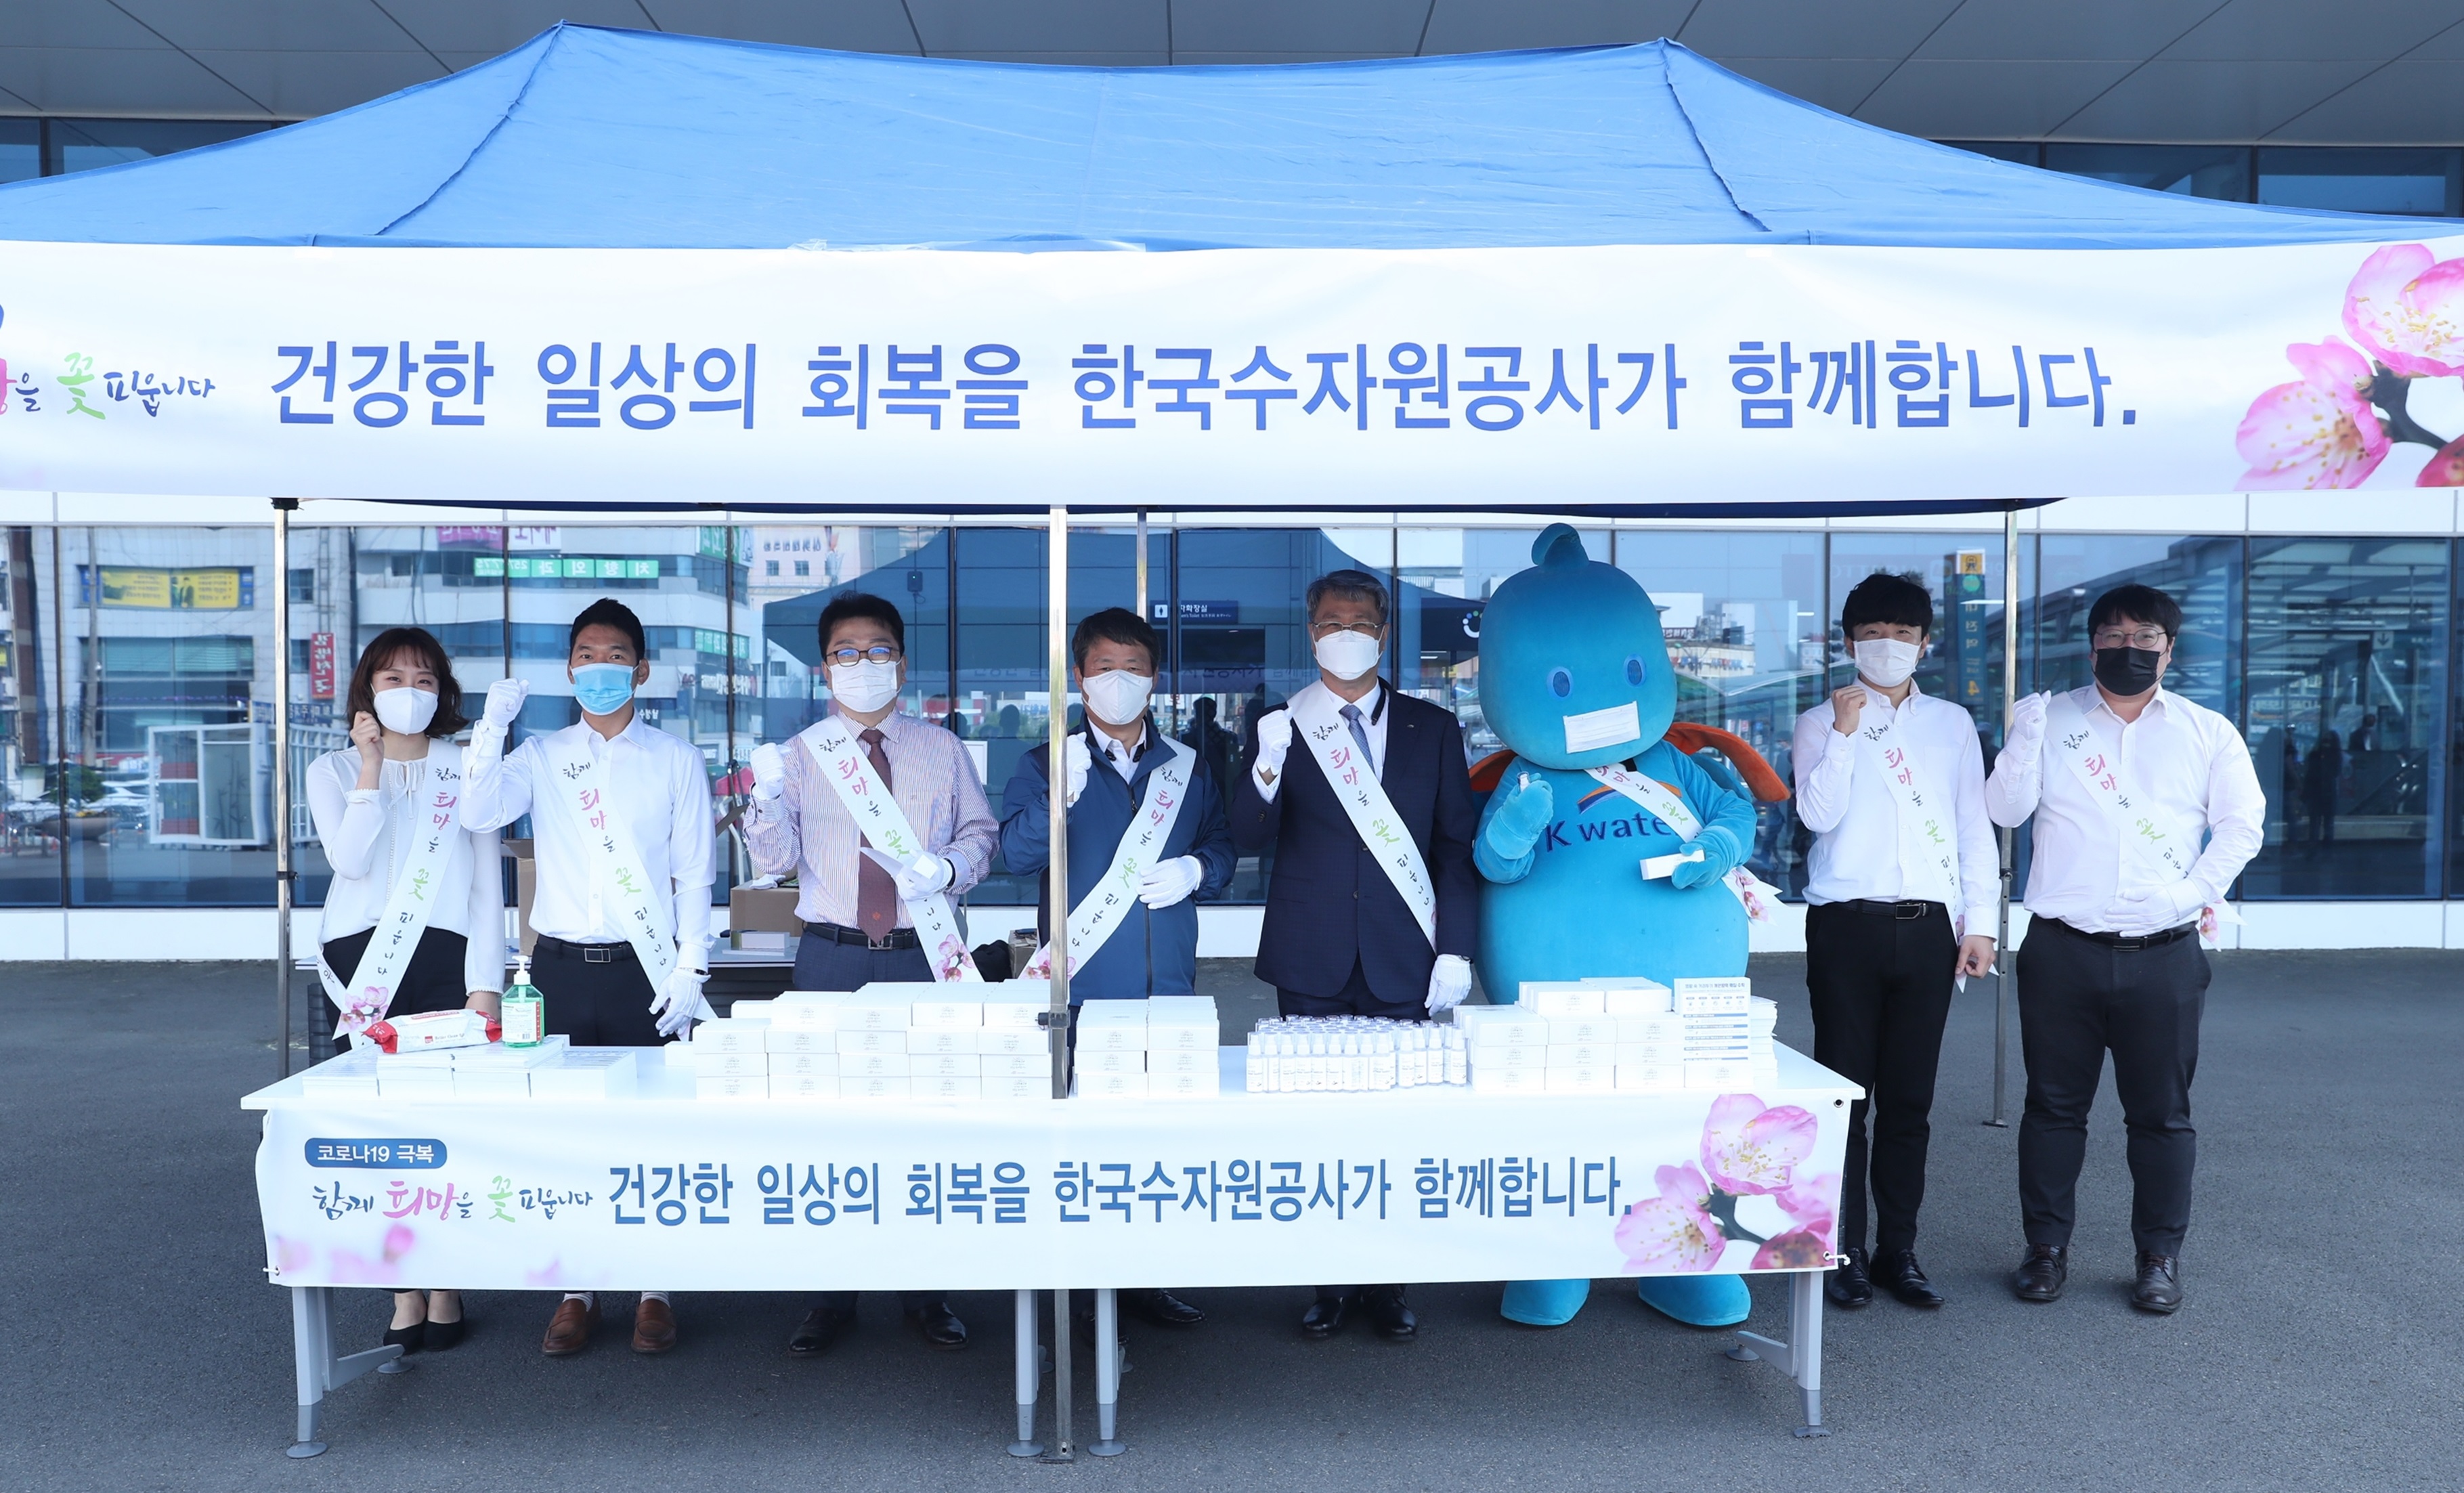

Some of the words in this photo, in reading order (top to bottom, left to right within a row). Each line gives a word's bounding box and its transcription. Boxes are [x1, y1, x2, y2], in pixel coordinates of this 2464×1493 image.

[271, 341, 494, 429] 건강한
[537, 342, 756, 431] 일상의
[802, 343, 1029, 431] 회복을
[1072, 342, 1687, 432] 한국수자원공사가
[1729, 340, 2136, 429] 함께합니다.
[1312, 722, 1339, 741] 함께
[1863, 724, 1890, 741] 함께
[2063, 730, 2090, 750] 함께
[819, 735, 847, 753] 함께
[563, 762, 591, 780] 함께
[1160, 766, 1184, 787] 함께
[1544, 818, 1573, 853] K
[1577, 811, 1679, 843] wate
[317, 1145, 391, 1163] 코로나19
[396, 1144, 435, 1163] 극복
[312, 1181, 374, 1221] 함께
[383, 1181, 474, 1221] 희망을
[609, 1163, 733, 1226] 건강한
[757, 1163, 880, 1226] 일상의
[905, 1161, 1030, 1225] 회복을
[1054, 1159, 1391, 1224] 한국수자원공사가
[1414, 1156, 1632, 1219] 함께합니다.
